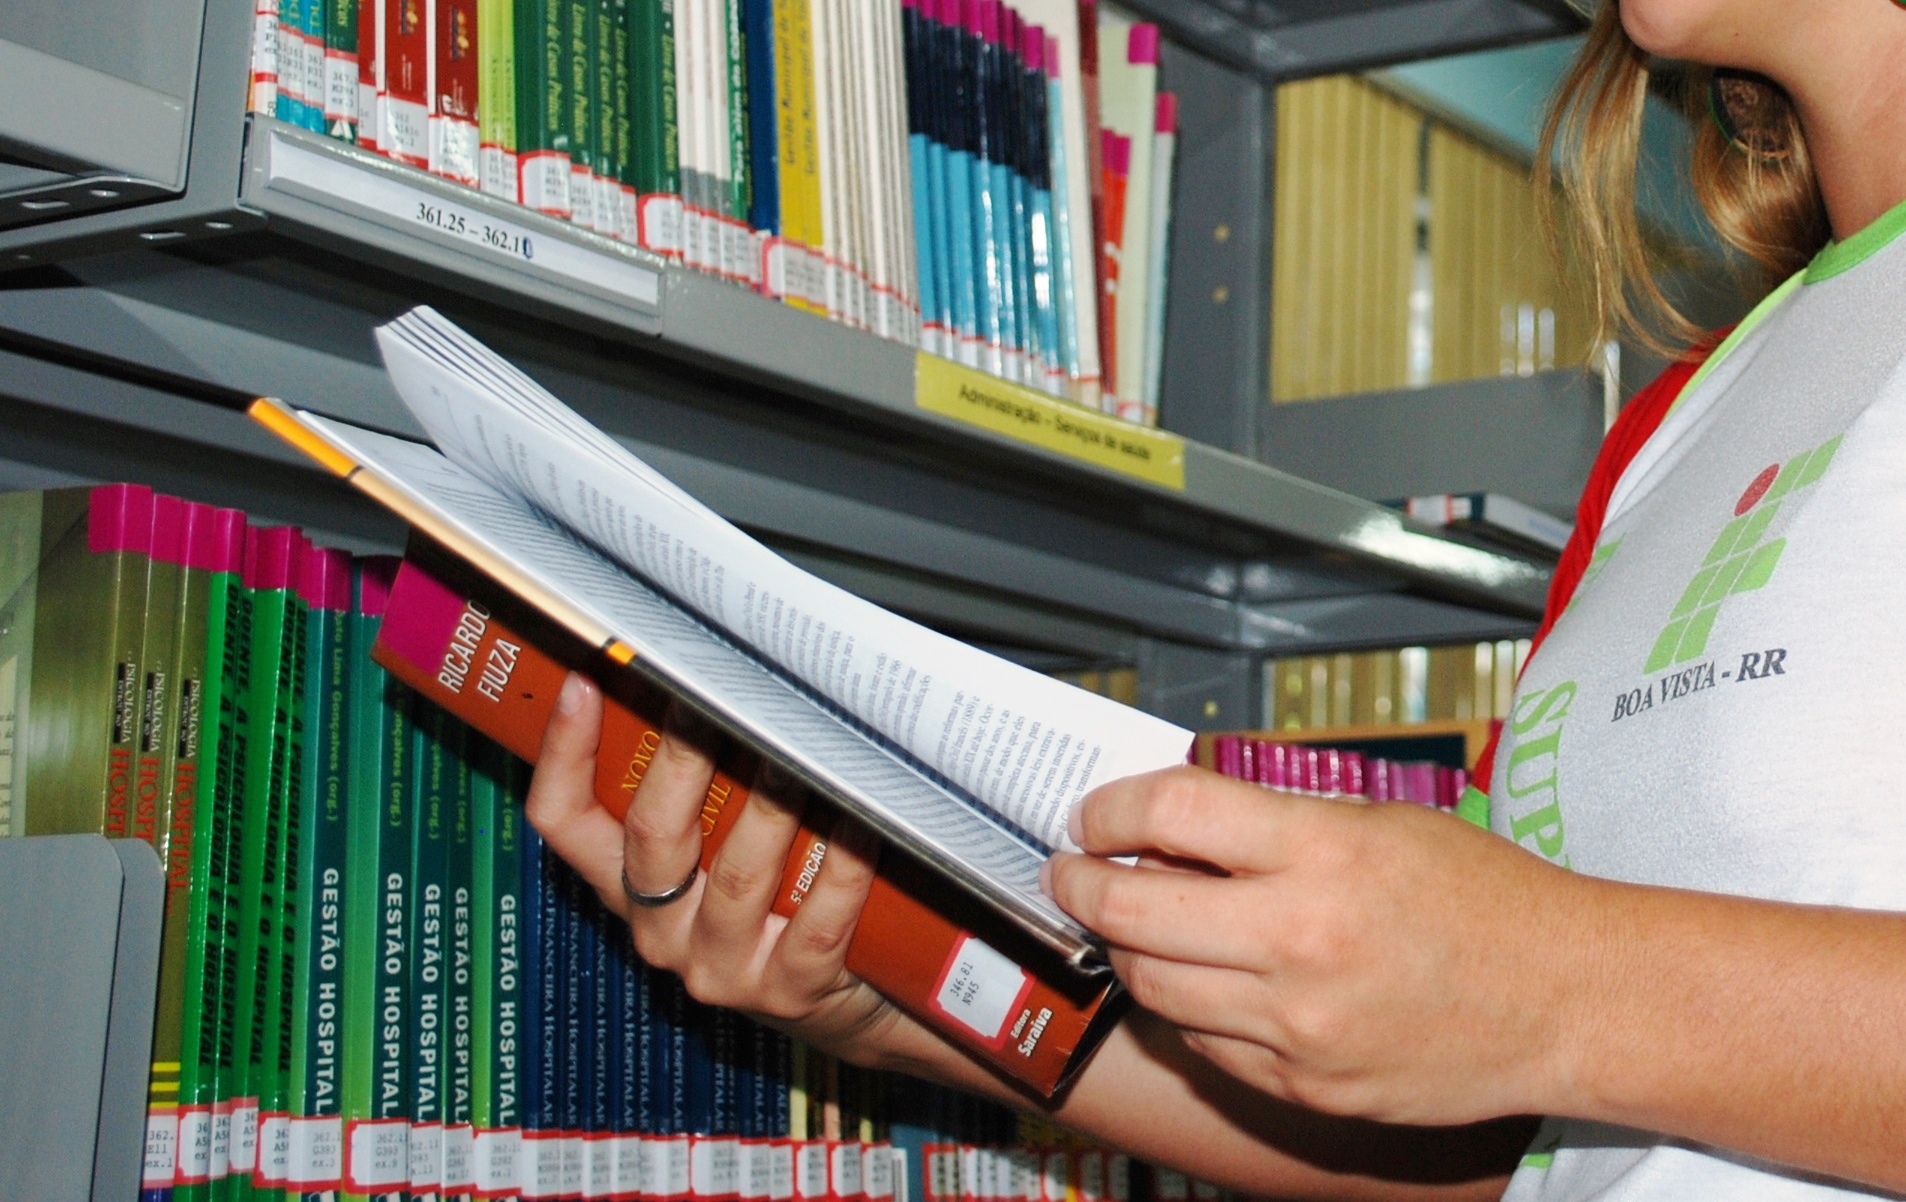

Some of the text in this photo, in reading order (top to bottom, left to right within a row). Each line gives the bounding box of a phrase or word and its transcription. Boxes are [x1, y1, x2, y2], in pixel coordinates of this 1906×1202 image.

[417, 202, 466, 234] 361.25
[332, 648, 344, 684] Lima
[438, 600, 490, 693] RICARDO
[478, 637, 522, 702] FIUZA
[1611, 687, 1654, 722] BOA
[1660, 661, 1717, 703] VISTA
[1736, 648, 1789, 682] RR
[122, 663, 137, 743] PSICOLOGIA
[151, 673, 166, 751] PSICOLOGIA
[187, 679, 201, 758] PSICOLOGIA
[219, 695, 233, 714] A
[235, 706, 247, 724] A
[291, 715, 303, 734] A
[330, 691, 343, 770] Gonçalves
[209, 722, 231, 878] PSICOLOGIA
[227, 733, 246, 885] PSICOLOGIA
[264, 733, 286, 884] PSICOLOGIA
[326, 776, 339, 821] (org.)
[390, 782, 402, 827] (org.)
[1506, 680, 1577, 872] SUP
[285, 743, 301, 891] PSICOLOGIA
[208, 887, 222, 903] E
[226, 894, 238, 910] E
[796, 842, 827, 892] EDIÇÃO
[207, 913, 221, 931] O
[225, 919, 237, 938] O
[283, 925, 295, 944] O
[284, 901, 296, 916] E
[316, 868, 339, 1115] GESTÃO HOSPITAL
[383, 873, 404, 1118] GESTÃO HOSPITAL
[544, 906, 556, 1010] FINANCEIRA
[950, 961, 974, 997] 346.81
[962, 982, 980, 1006] N945
[199, 941, 219, 1067] HOSPITAL
[219, 948, 236, 1069] HOSPITAL
[250, 945, 269, 1066] HOSPITAL
[279, 953, 294, 1073] HOSPITAL
[418, 884, 441, 1122] GESTÃO HOSPITAL
[455, 887, 470, 1124] GESTÃO HOSPITAL
[500, 895, 518, 1126] GESTÃO HOSPITAL
[567, 911, 579, 1126] FINANCEIRA HOSPITALAR
[1011, 1008, 1032, 1039] Editora
[1018, 1007, 1053, 1057] Saraiva
[543, 1015, 555, 1124] HOSPITALAR
[594, 1019, 606, 1125] HOSPITALAR
[623, 1022, 635, 1127] HOSPITALAR
[639, 1025, 650, 1130] HOSPITALAR
[673, 1026, 685, 1130] HOSPITALAR
